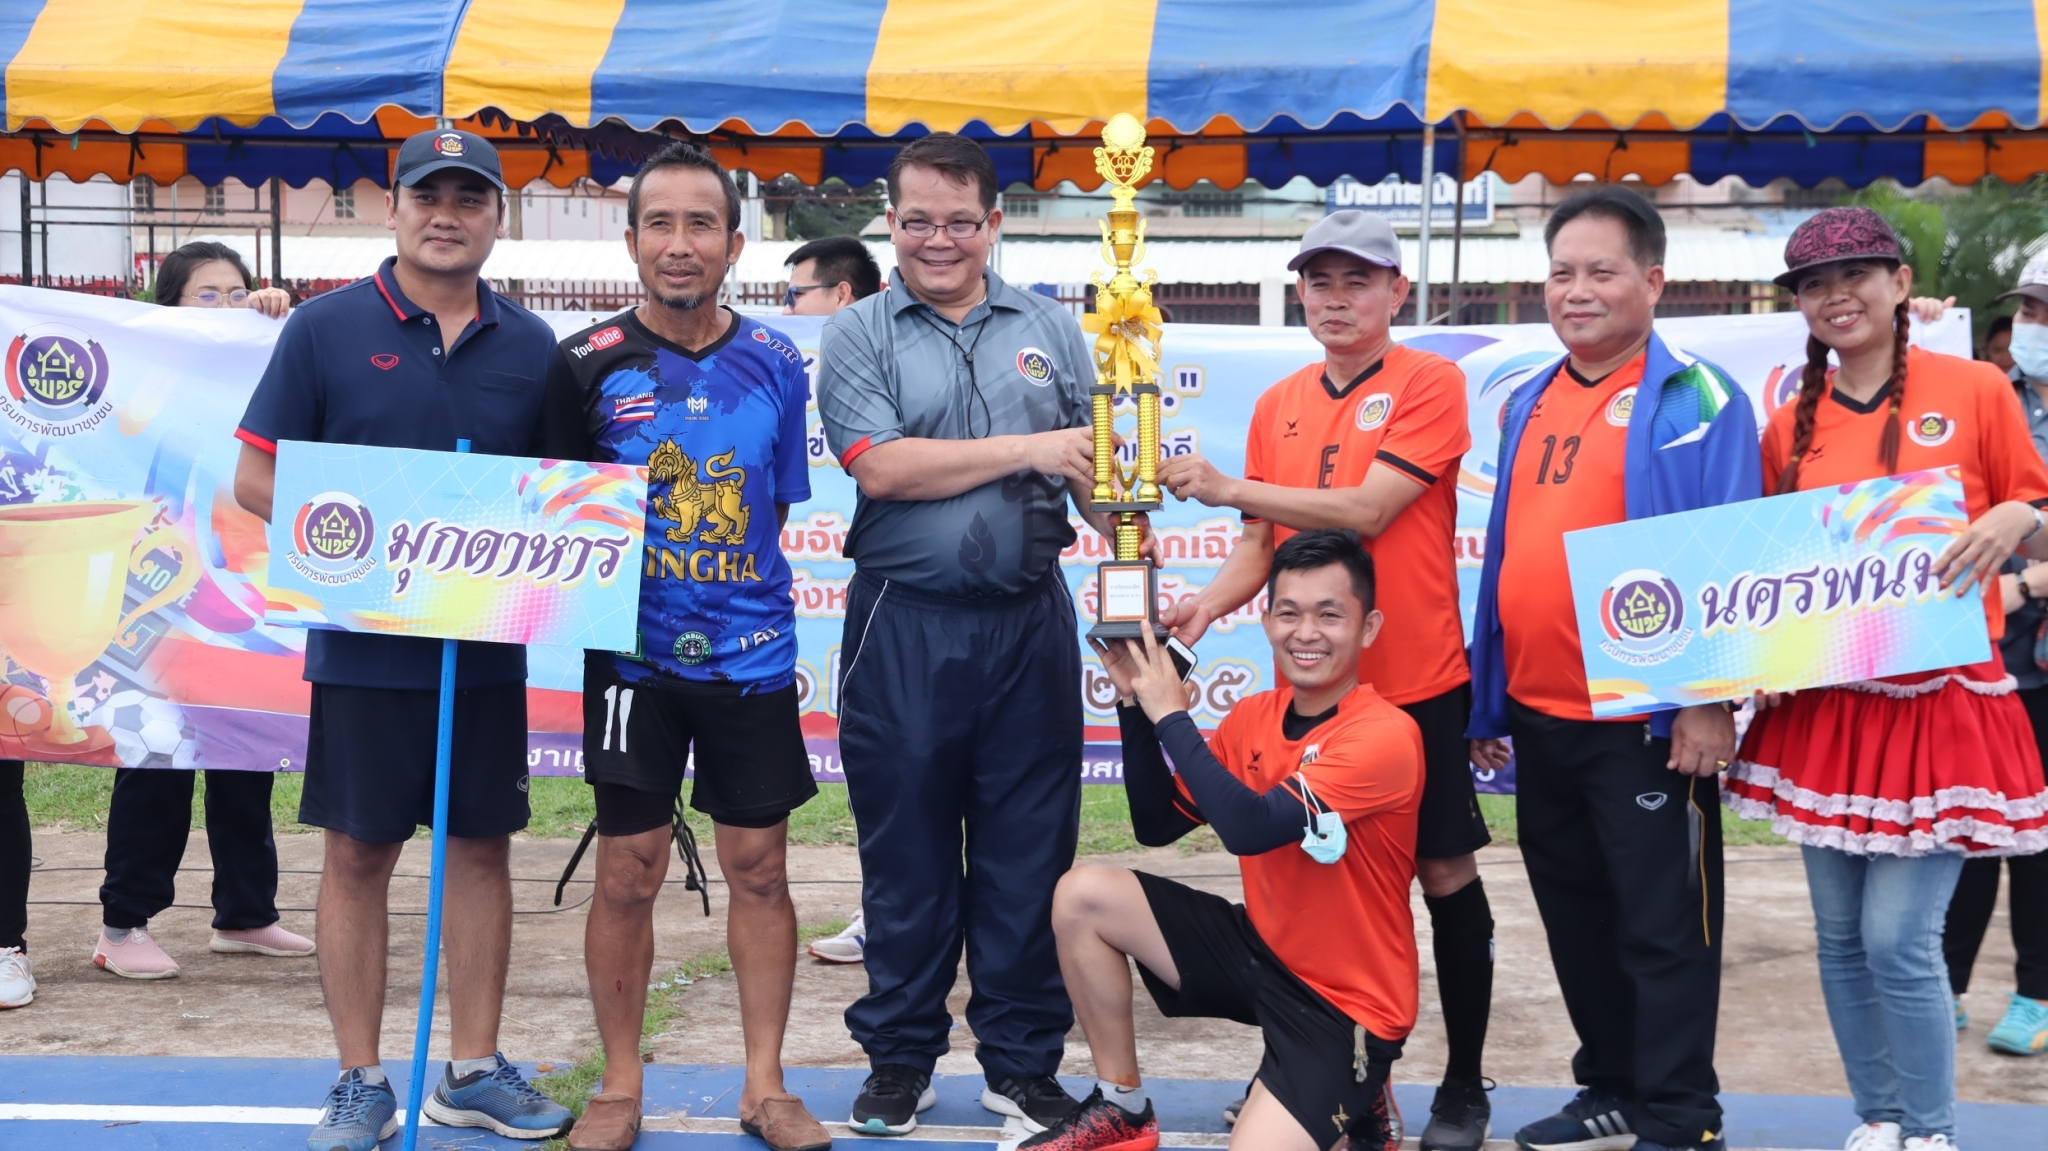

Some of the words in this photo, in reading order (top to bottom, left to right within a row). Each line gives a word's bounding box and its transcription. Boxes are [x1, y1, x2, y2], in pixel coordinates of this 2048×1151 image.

[571, 326, 621, 358] YouTube
[1535, 434, 1581, 485] 13
[287, 550, 377, 584] กรมการพัฒนาชุมชน
[388, 521, 630, 593] มุกดาหาร
[645, 545, 764, 583] INGHA
[675, 632, 709, 649] STARBUCKS
[602, 685, 634, 753] 11
